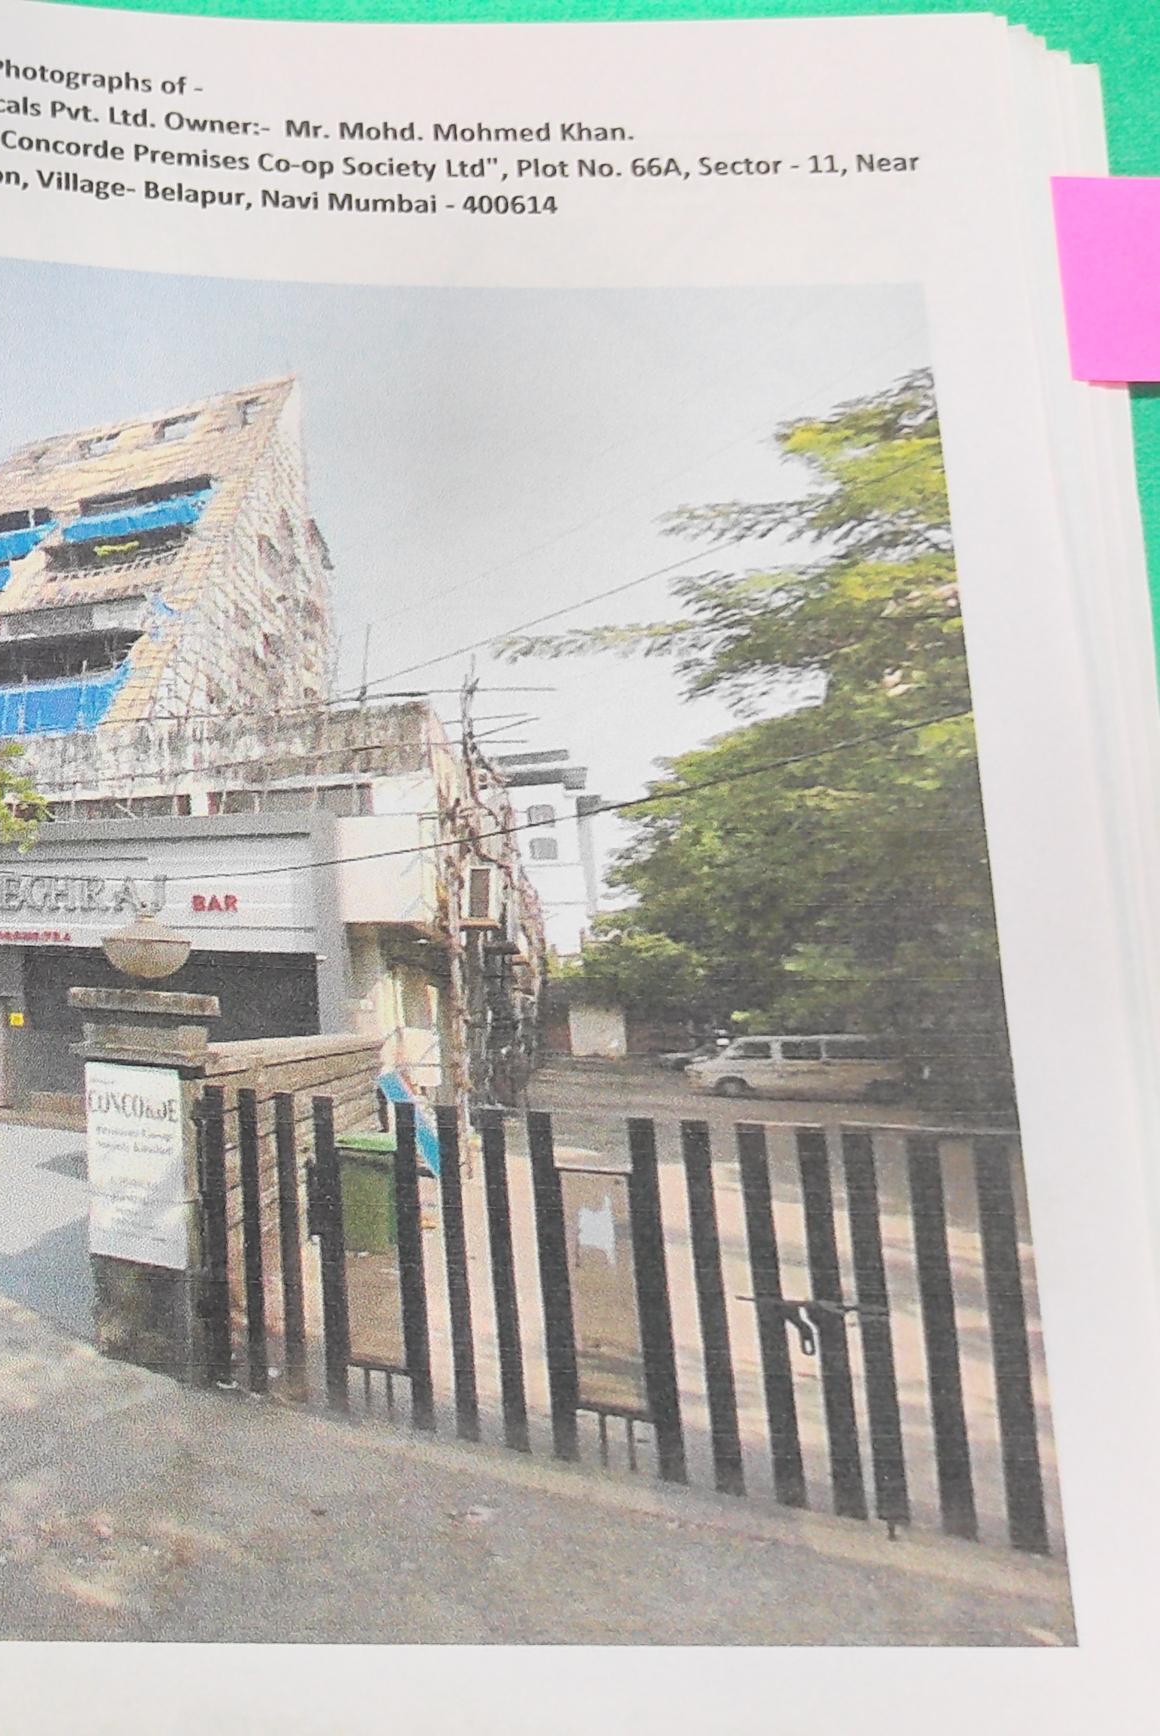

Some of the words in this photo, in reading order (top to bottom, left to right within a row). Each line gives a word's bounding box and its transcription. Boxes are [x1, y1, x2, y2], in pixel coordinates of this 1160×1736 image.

[160, 76, 187, 95] of
[50, 100, 100, 123] Pvt.
[109, 106, 156, 128] Ltd.
[164, 111, 271, 136] Owner:-
[285, 119, 330, 139] Mr.
[339, 121, 424, 142] Mohd.
[433, 122, 551, 143] Mohmed
[560, 121, 634, 142] Khan.
[0, 129, 125, 161] Concorde
[133, 143, 250, 171] Premises
[257, 152, 335, 180] Co-op
[342, 156, 437, 183] Society
[446, 157, 508, 182] Ltd",
[516, 157, 569, 178] Plot
[577, 158, 622, 178] No.
[630, 157, 691, 181] 66A,
[698, 156, 783, 177] Sector
[808, 154, 848, 177] 11,
[855, 153, 920, 173] Near
[36, 169, 136, 201] Village-
[144, 180, 253, 211] Belapur,
[261, 189, 319, 211] Navi
[327, 192, 437, 214] Mumbai
[462, 194, 559, 215] 400614
[191, 894, 239, 913] BAR
